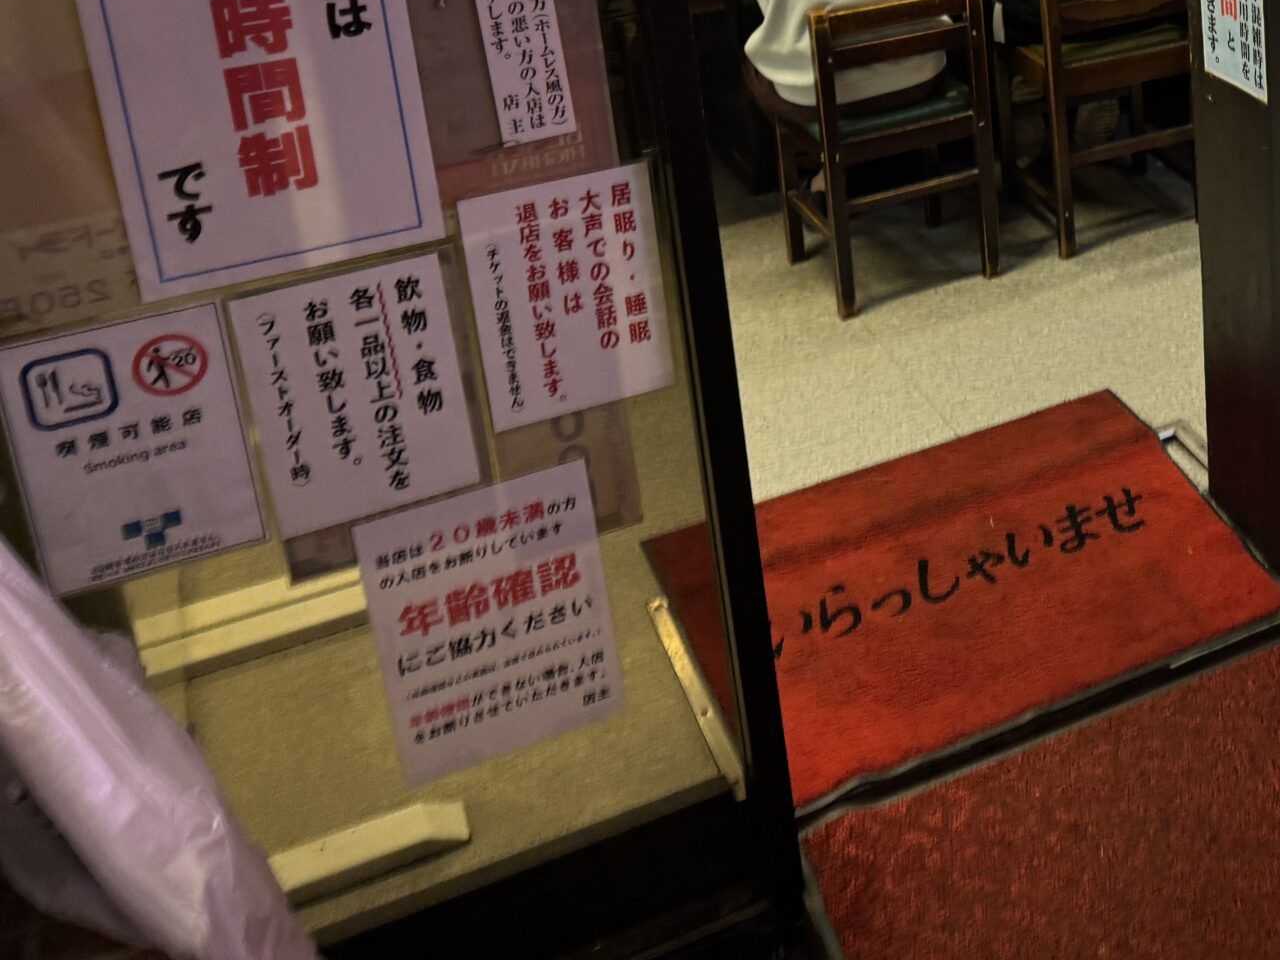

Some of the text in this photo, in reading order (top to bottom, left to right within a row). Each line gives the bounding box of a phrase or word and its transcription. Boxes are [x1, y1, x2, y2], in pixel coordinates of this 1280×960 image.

[157, 161, 213, 244] です
[548, 197, 584, 317] お客様は
[515, 201, 567, 402] 退店をお願い致します。
[579, 187, 620, 350] 大声での会話の
[302, 298, 363, 466] お願い致します。
[350, 287, 411, 490] 各一品以上の注文を
[393, 273, 444, 415] 飲物・食物
[55, 407, 203, 458] 喫煙可能店
[398, 551, 583, 639] 年齢確認
[398, 594, 594, 678] にご協力ください
